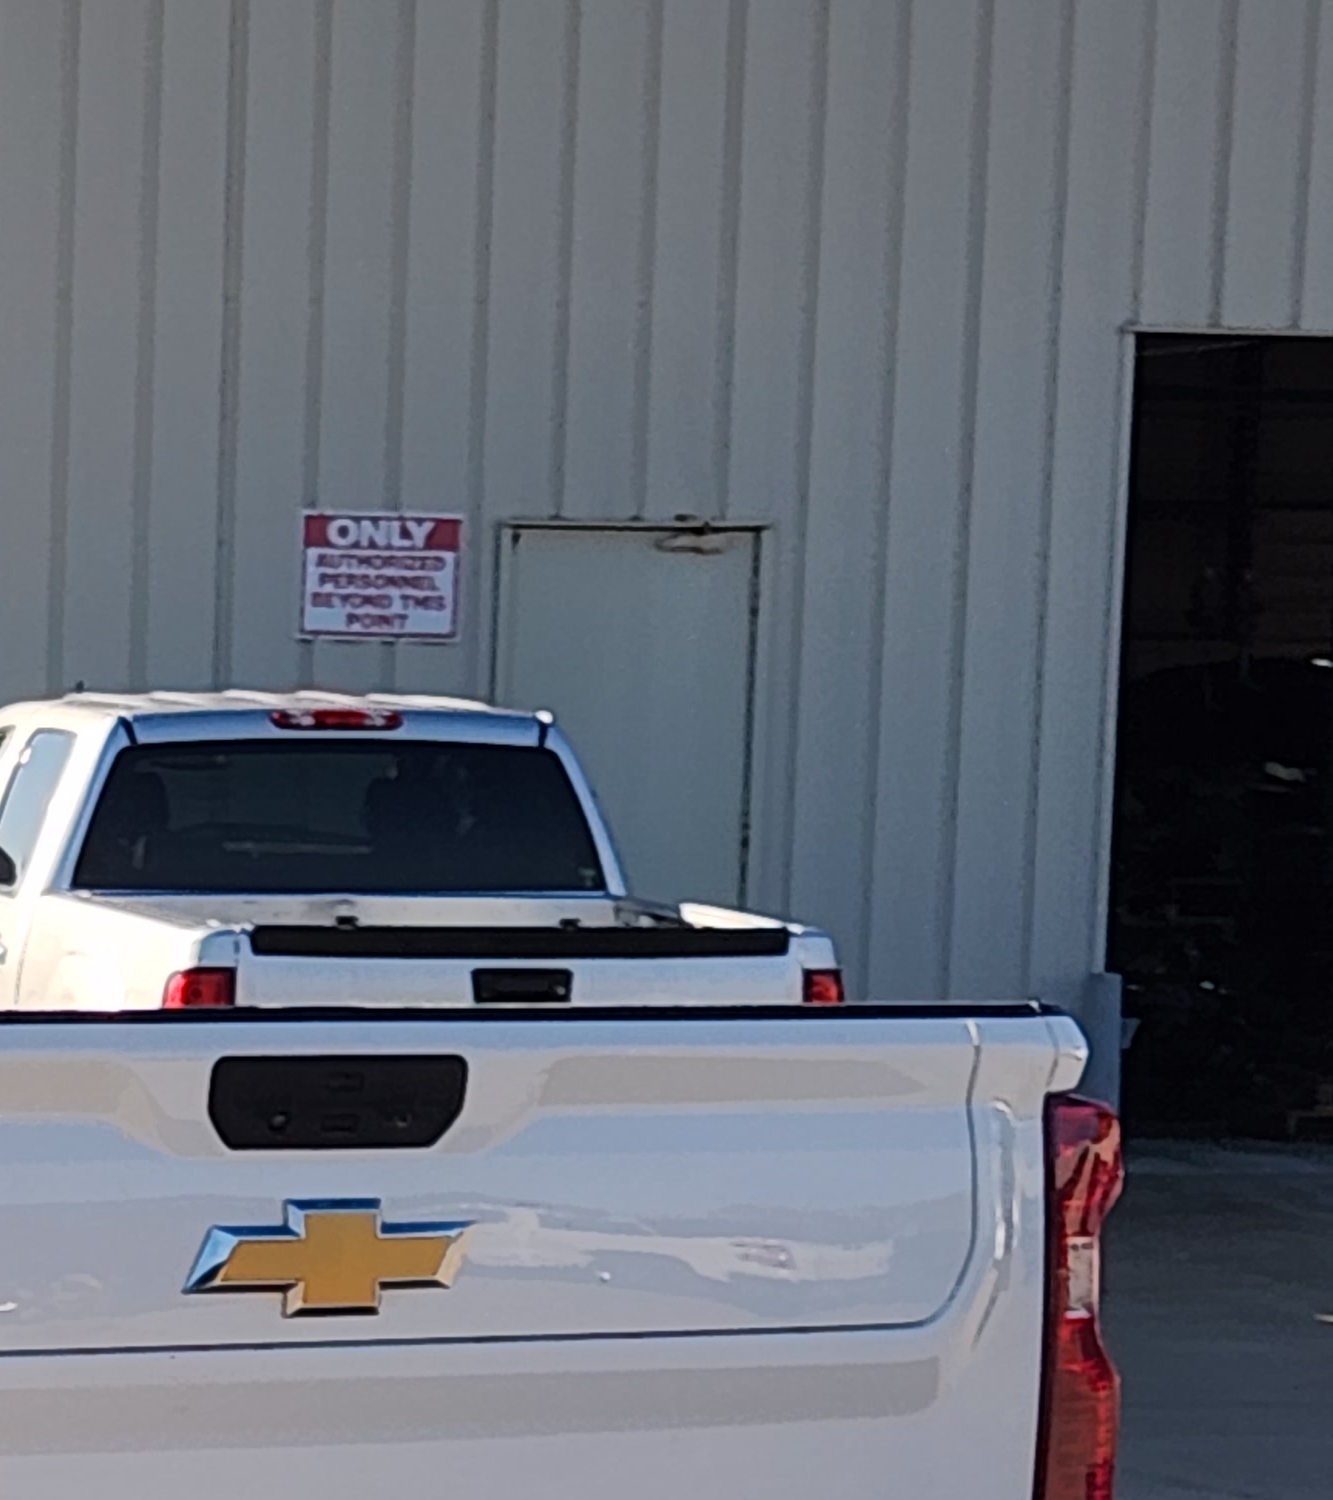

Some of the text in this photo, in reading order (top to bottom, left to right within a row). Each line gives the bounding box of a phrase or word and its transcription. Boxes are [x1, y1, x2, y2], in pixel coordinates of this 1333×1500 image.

[327, 518, 435, 549] ONLY
[310, 592, 446, 611] BEYOND THIS
[346, 612, 409, 630] POINT
